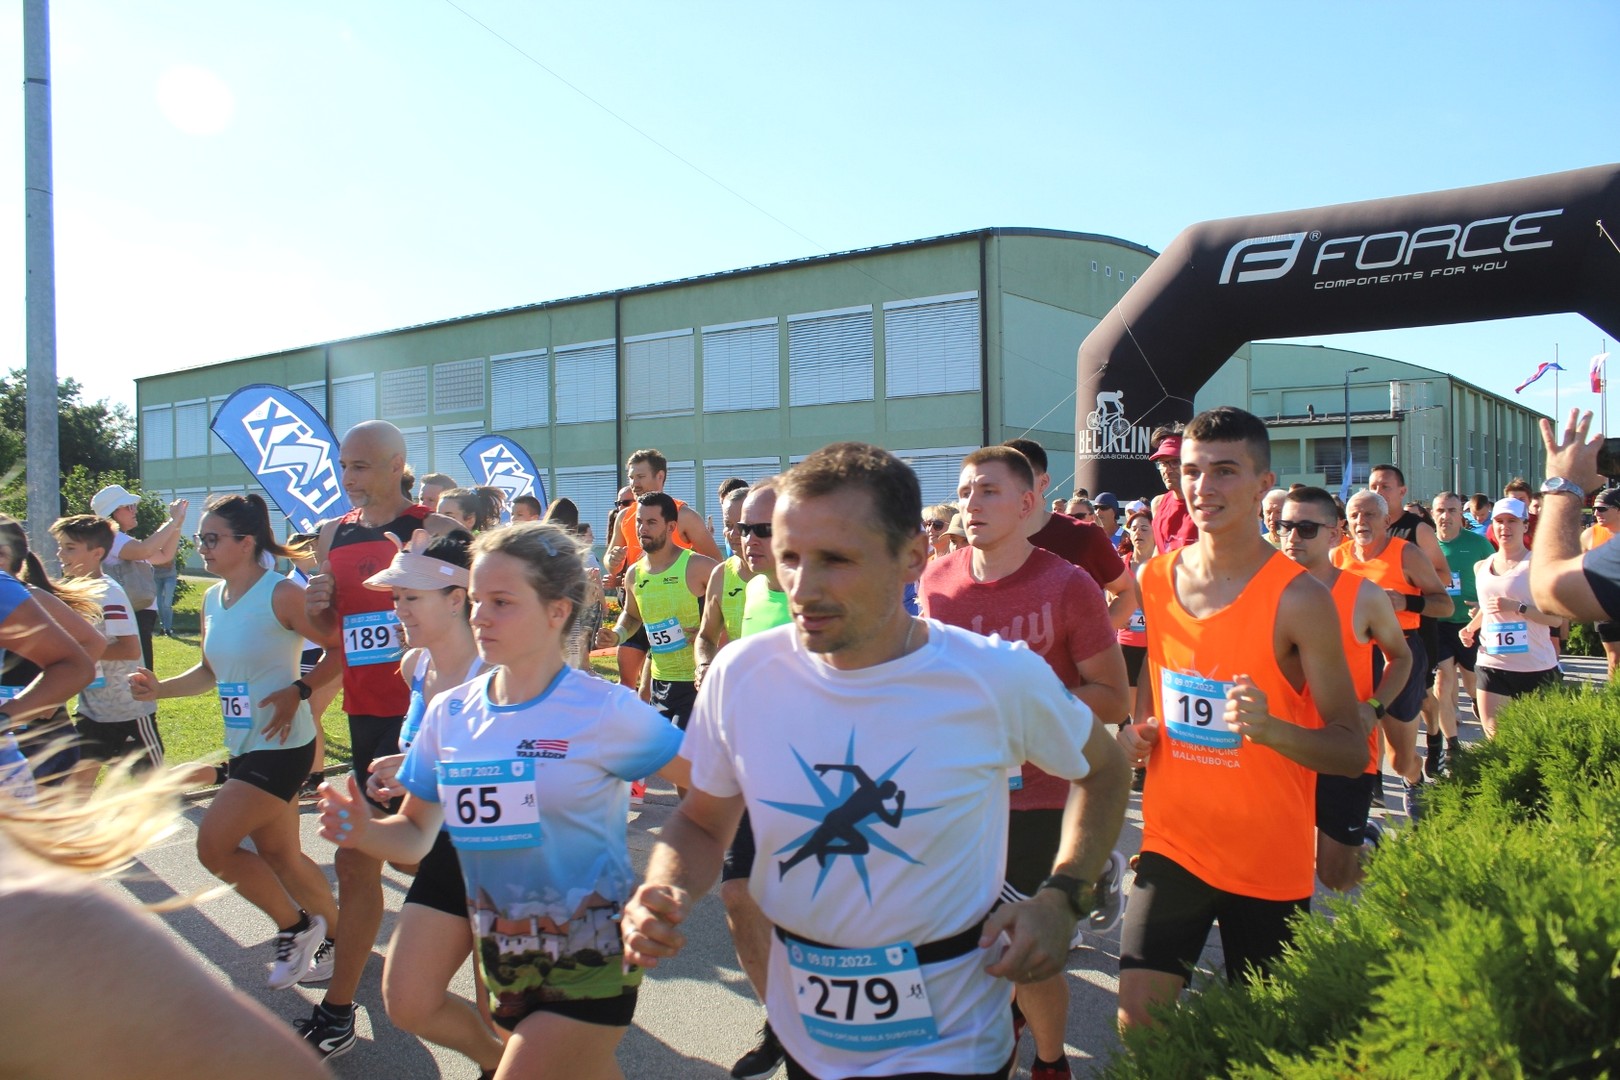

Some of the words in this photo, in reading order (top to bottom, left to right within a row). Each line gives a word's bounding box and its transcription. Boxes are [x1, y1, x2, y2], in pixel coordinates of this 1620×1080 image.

[1312, 208, 1564, 275] FORCE
[1314, 271, 1424, 290] COMPONENTS
[1430, 266, 1466, 278] FOR
[1472, 260, 1508, 273] YOU
[349, 626, 390, 651] 189
[652, 630, 672, 645] 55
[1496, 632, 1515, 646] 16
[1178, 695, 1213, 727] 19
[456, 786, 502, 825] 65
[807, 975, 899, 1021] 279
